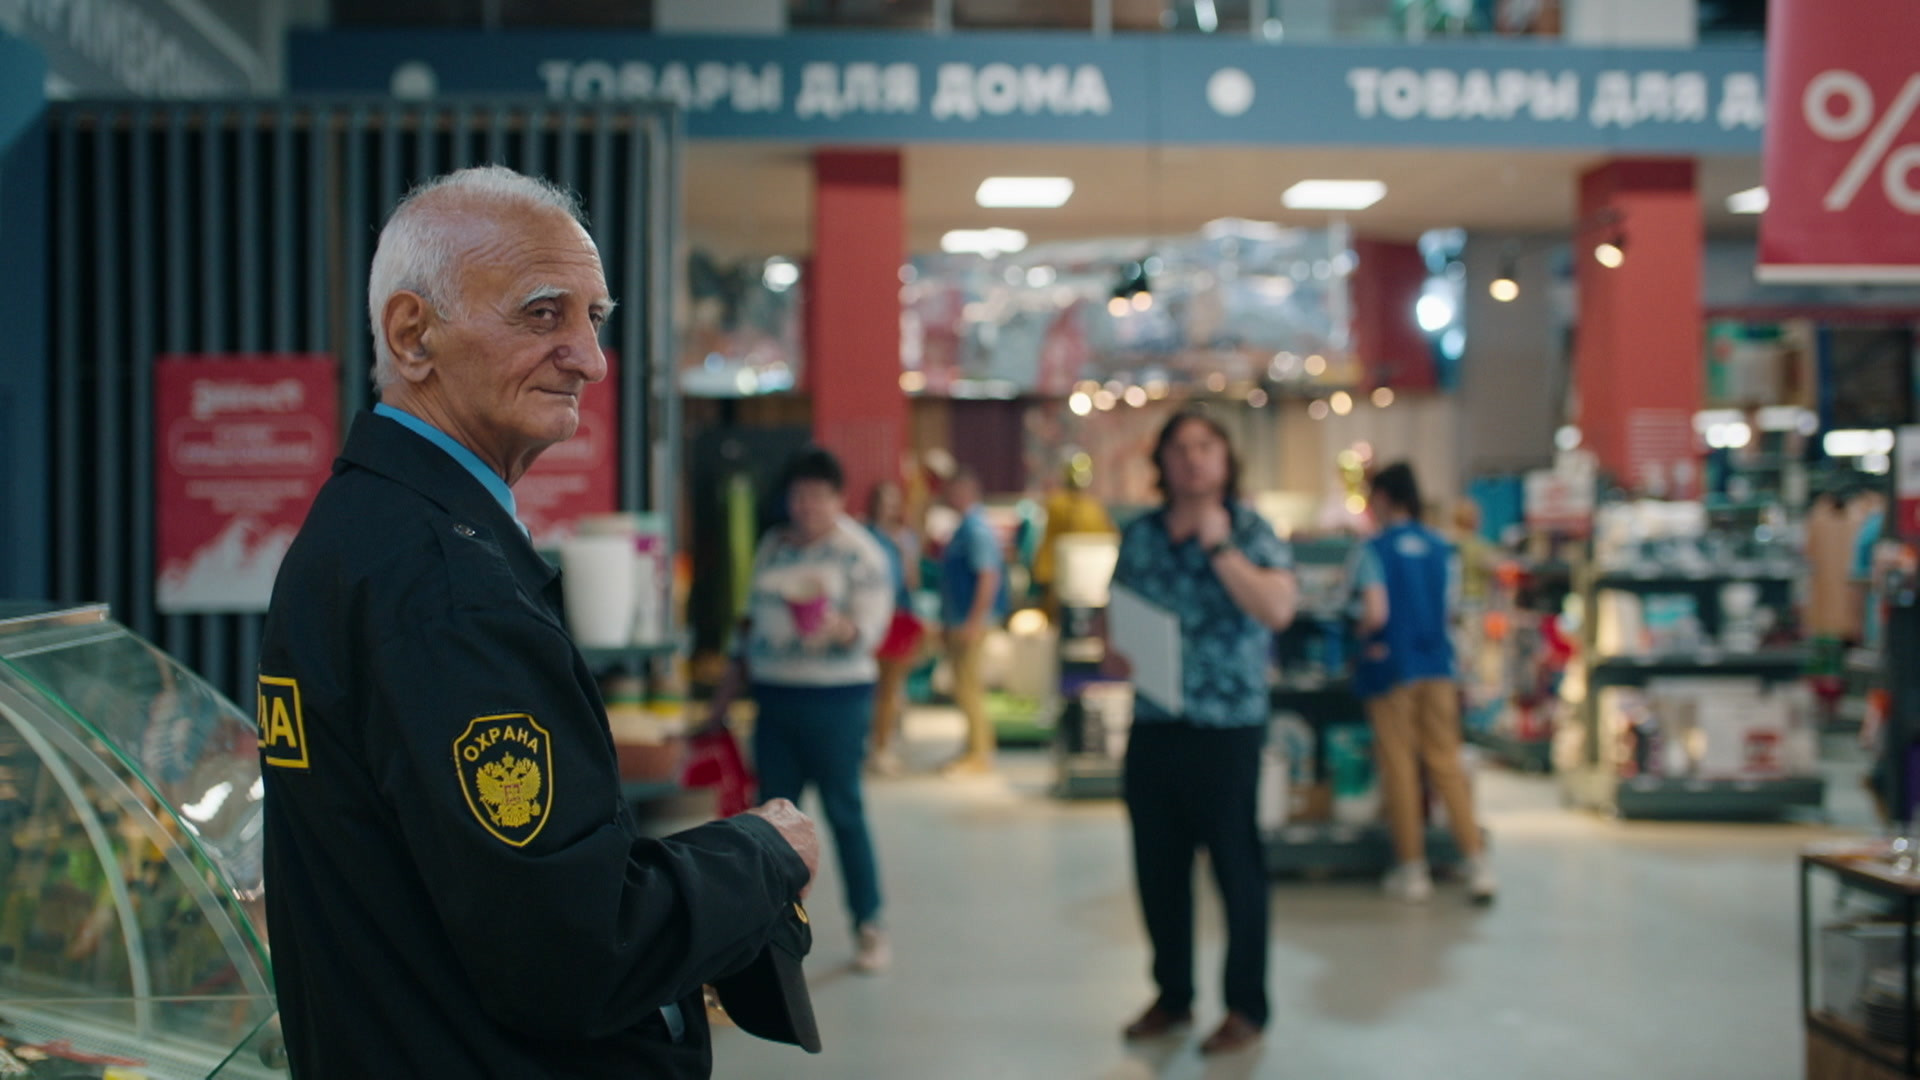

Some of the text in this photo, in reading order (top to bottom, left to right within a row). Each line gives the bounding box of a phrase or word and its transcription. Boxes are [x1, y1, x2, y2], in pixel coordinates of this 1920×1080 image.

[539, 61, 1112, 121] ТОВАРЫ ДЛЯ ДОМА
[1346, 68, 1580, 121] ТОВАРЫ
[1590, 70, 1708, 128] ДЛЯ
[463, 725, 538, 762] ОХРАНА
